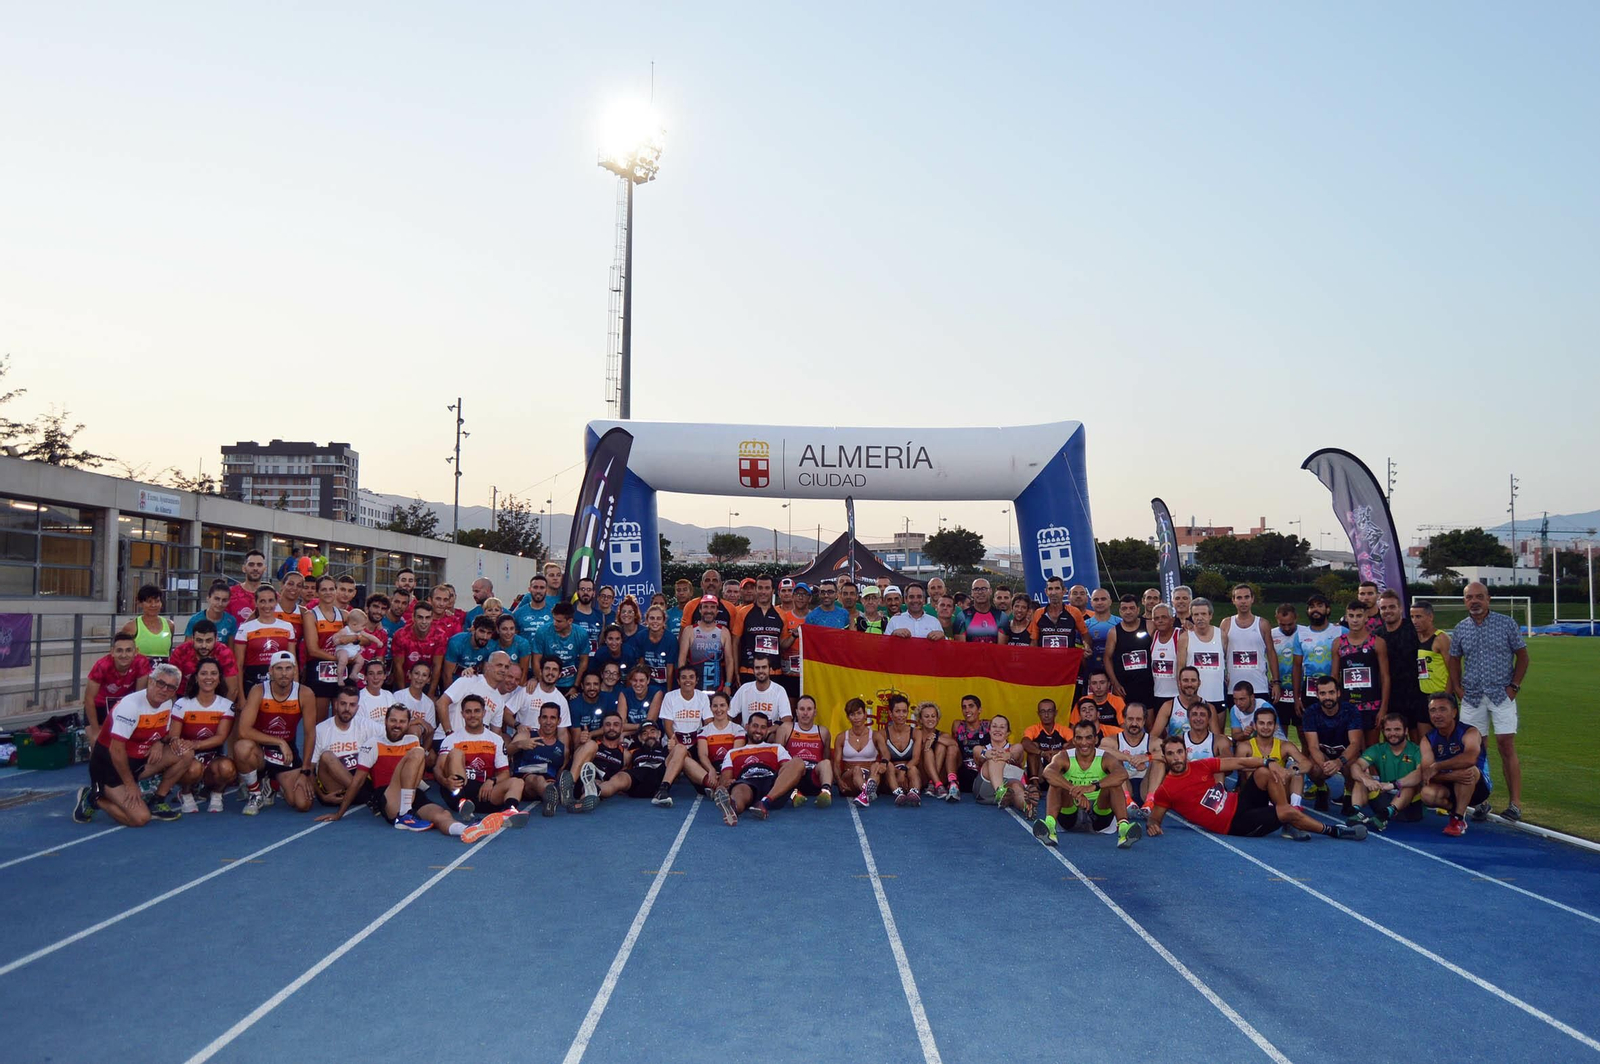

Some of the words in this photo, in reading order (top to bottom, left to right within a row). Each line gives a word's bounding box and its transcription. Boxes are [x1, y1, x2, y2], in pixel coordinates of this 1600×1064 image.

[798, 441, 933, 469] ALMERÍA
[798, 472, 867, 487] CIUDAD
[1130, 656, 1140, 664] 34
[1202, 657, 1212, 665] 34
[1157, 665, 1167, 673] 34
[758, 702, 773, 712] ISE
[686, 709, 700, 719] ISE
[341, 741, 357, 752] ISE
[345, 759, 357, 768] 30
[1213, 790, 1223, 802] 32
